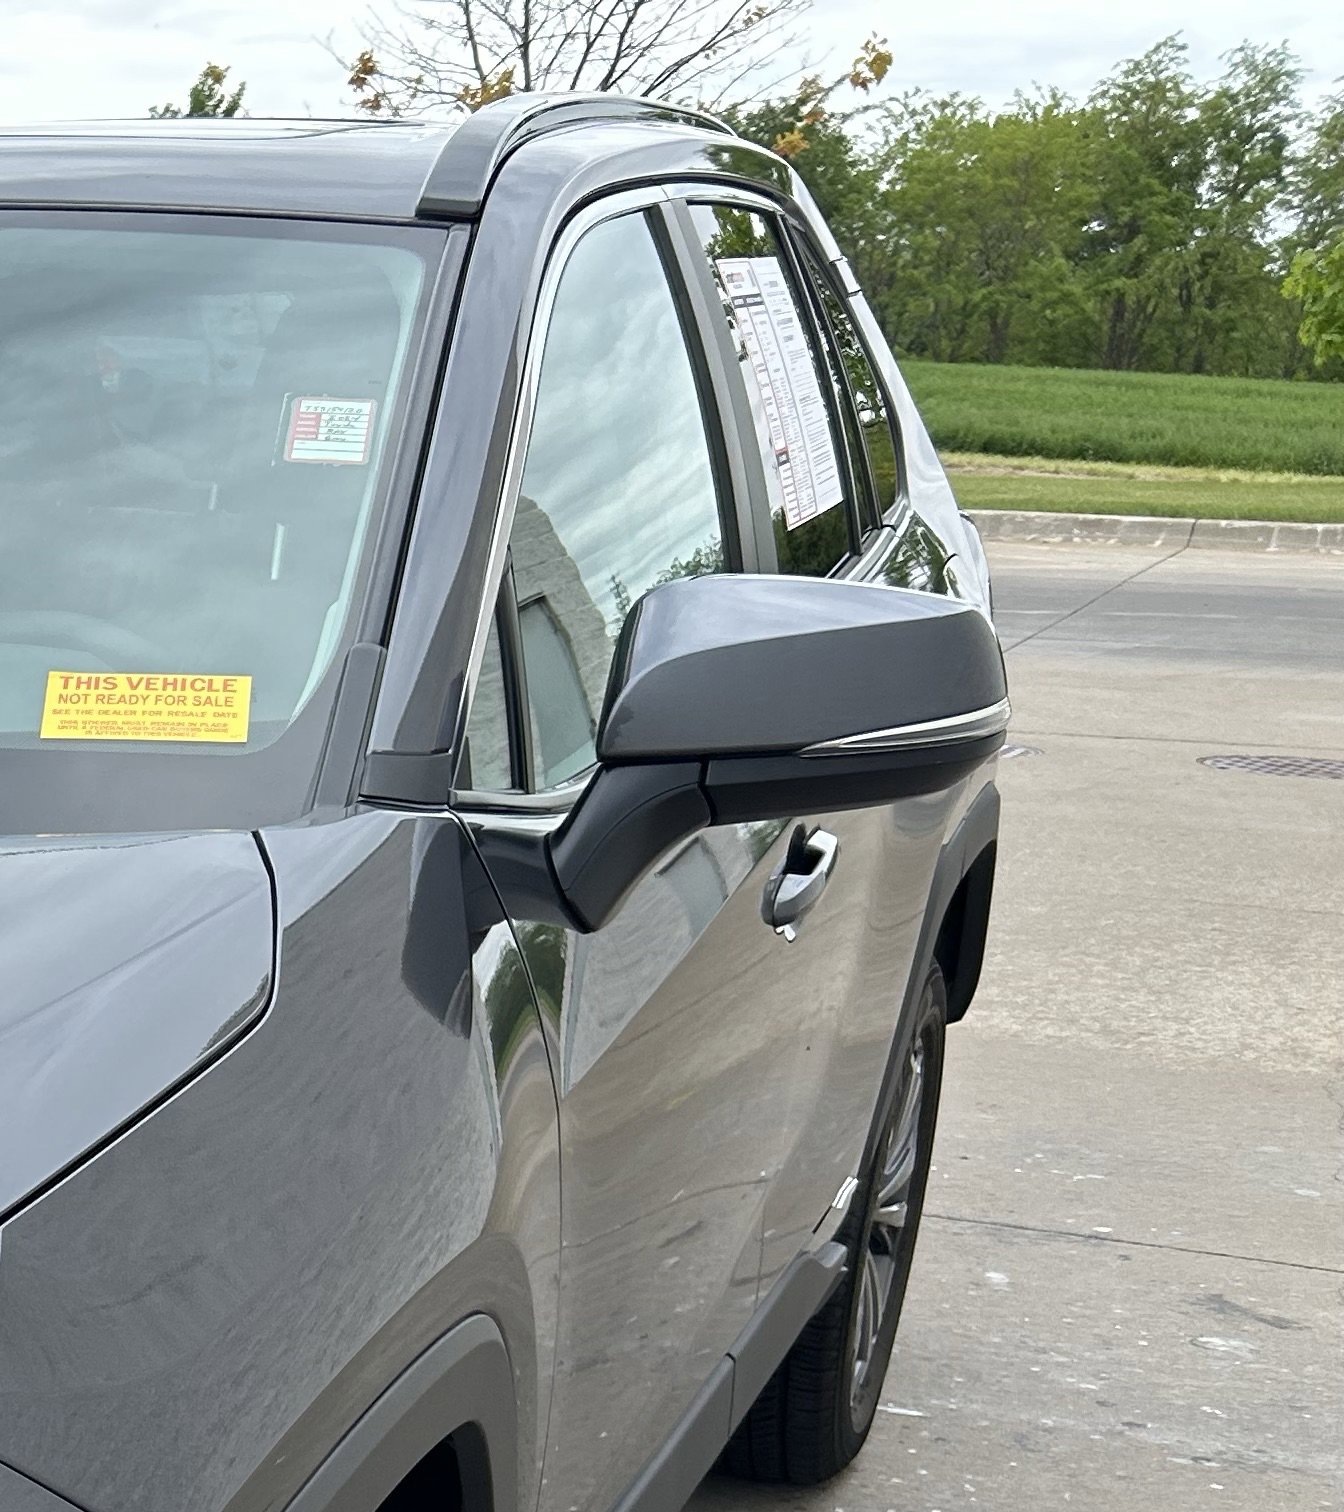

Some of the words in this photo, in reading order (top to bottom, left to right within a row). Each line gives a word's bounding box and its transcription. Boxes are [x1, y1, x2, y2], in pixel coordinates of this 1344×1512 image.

[59, 675, 119, 691] THIS
[125, 676, 239, 693] VEHICLE
[58, 693, 91, 705] NOT
[95, 693, 150, 706] READY
[154, 694, 188, 706] FOR
[192, 695, 235, 708] SALE
[98, 709, 138, 717] DEALER
